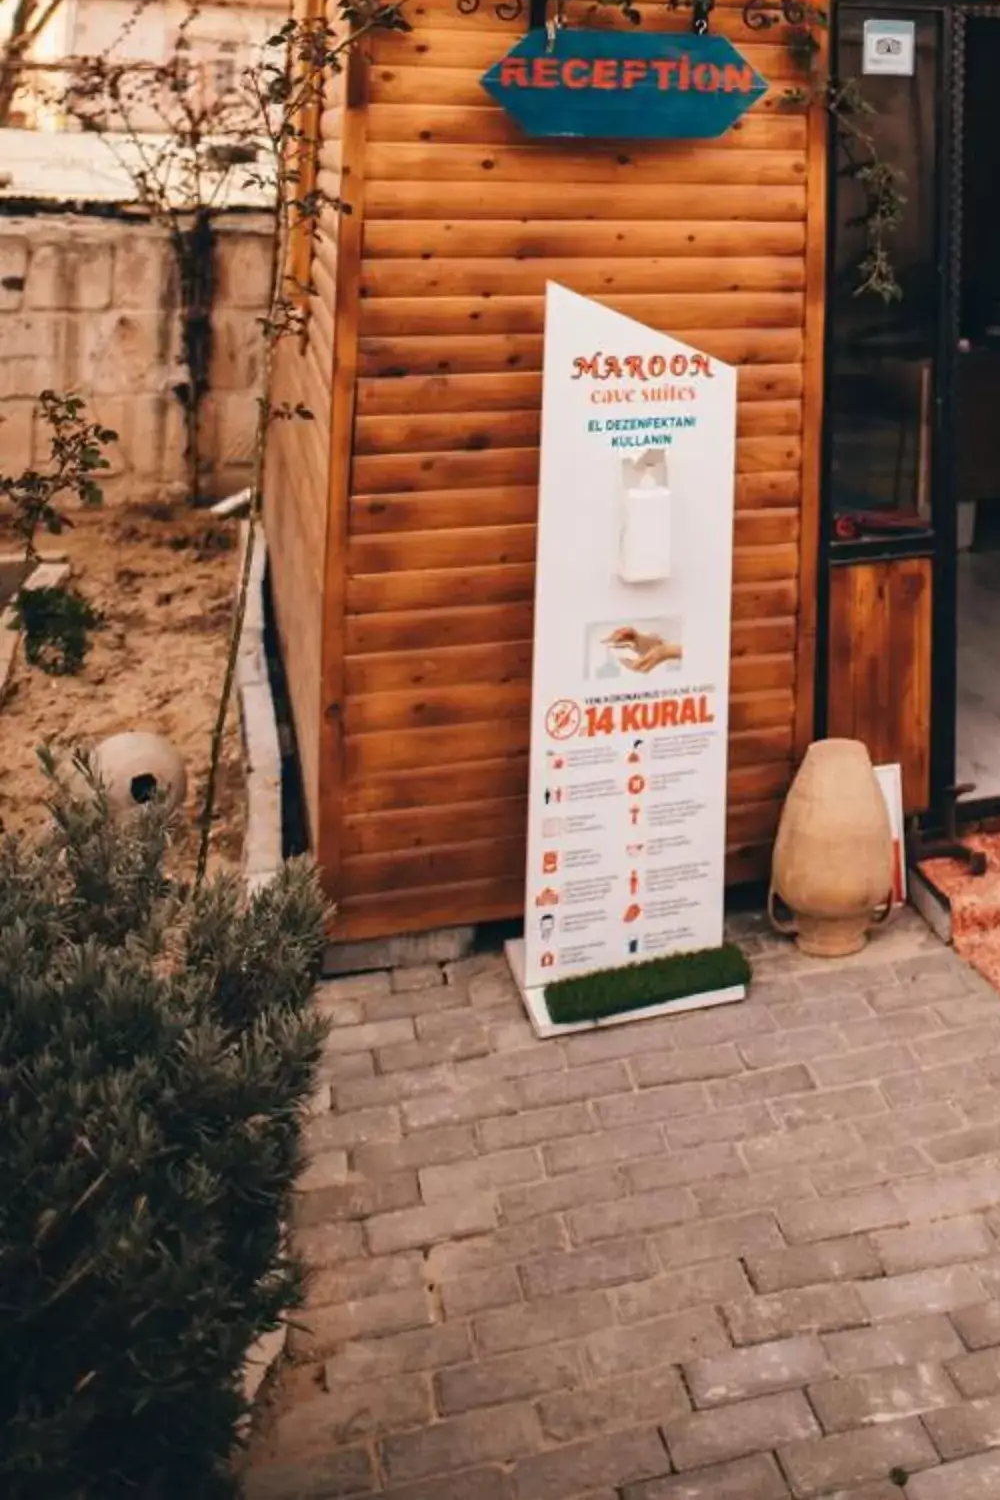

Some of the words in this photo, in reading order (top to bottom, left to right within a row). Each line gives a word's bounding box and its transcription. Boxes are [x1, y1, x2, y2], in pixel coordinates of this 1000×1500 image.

[570, 351, 714, 381] MAROON
[591, 387, 636, 404] cave
[641, 383, 697, 402] suites
[587, 419, 602, 432] EL
[606, 416, 696, 431] DEZENFEKTANI
[611, 434, 672, 447] KULLANIN
[585, 706, 614, 737] 14
[621, 694, 715, 731] KURAL
